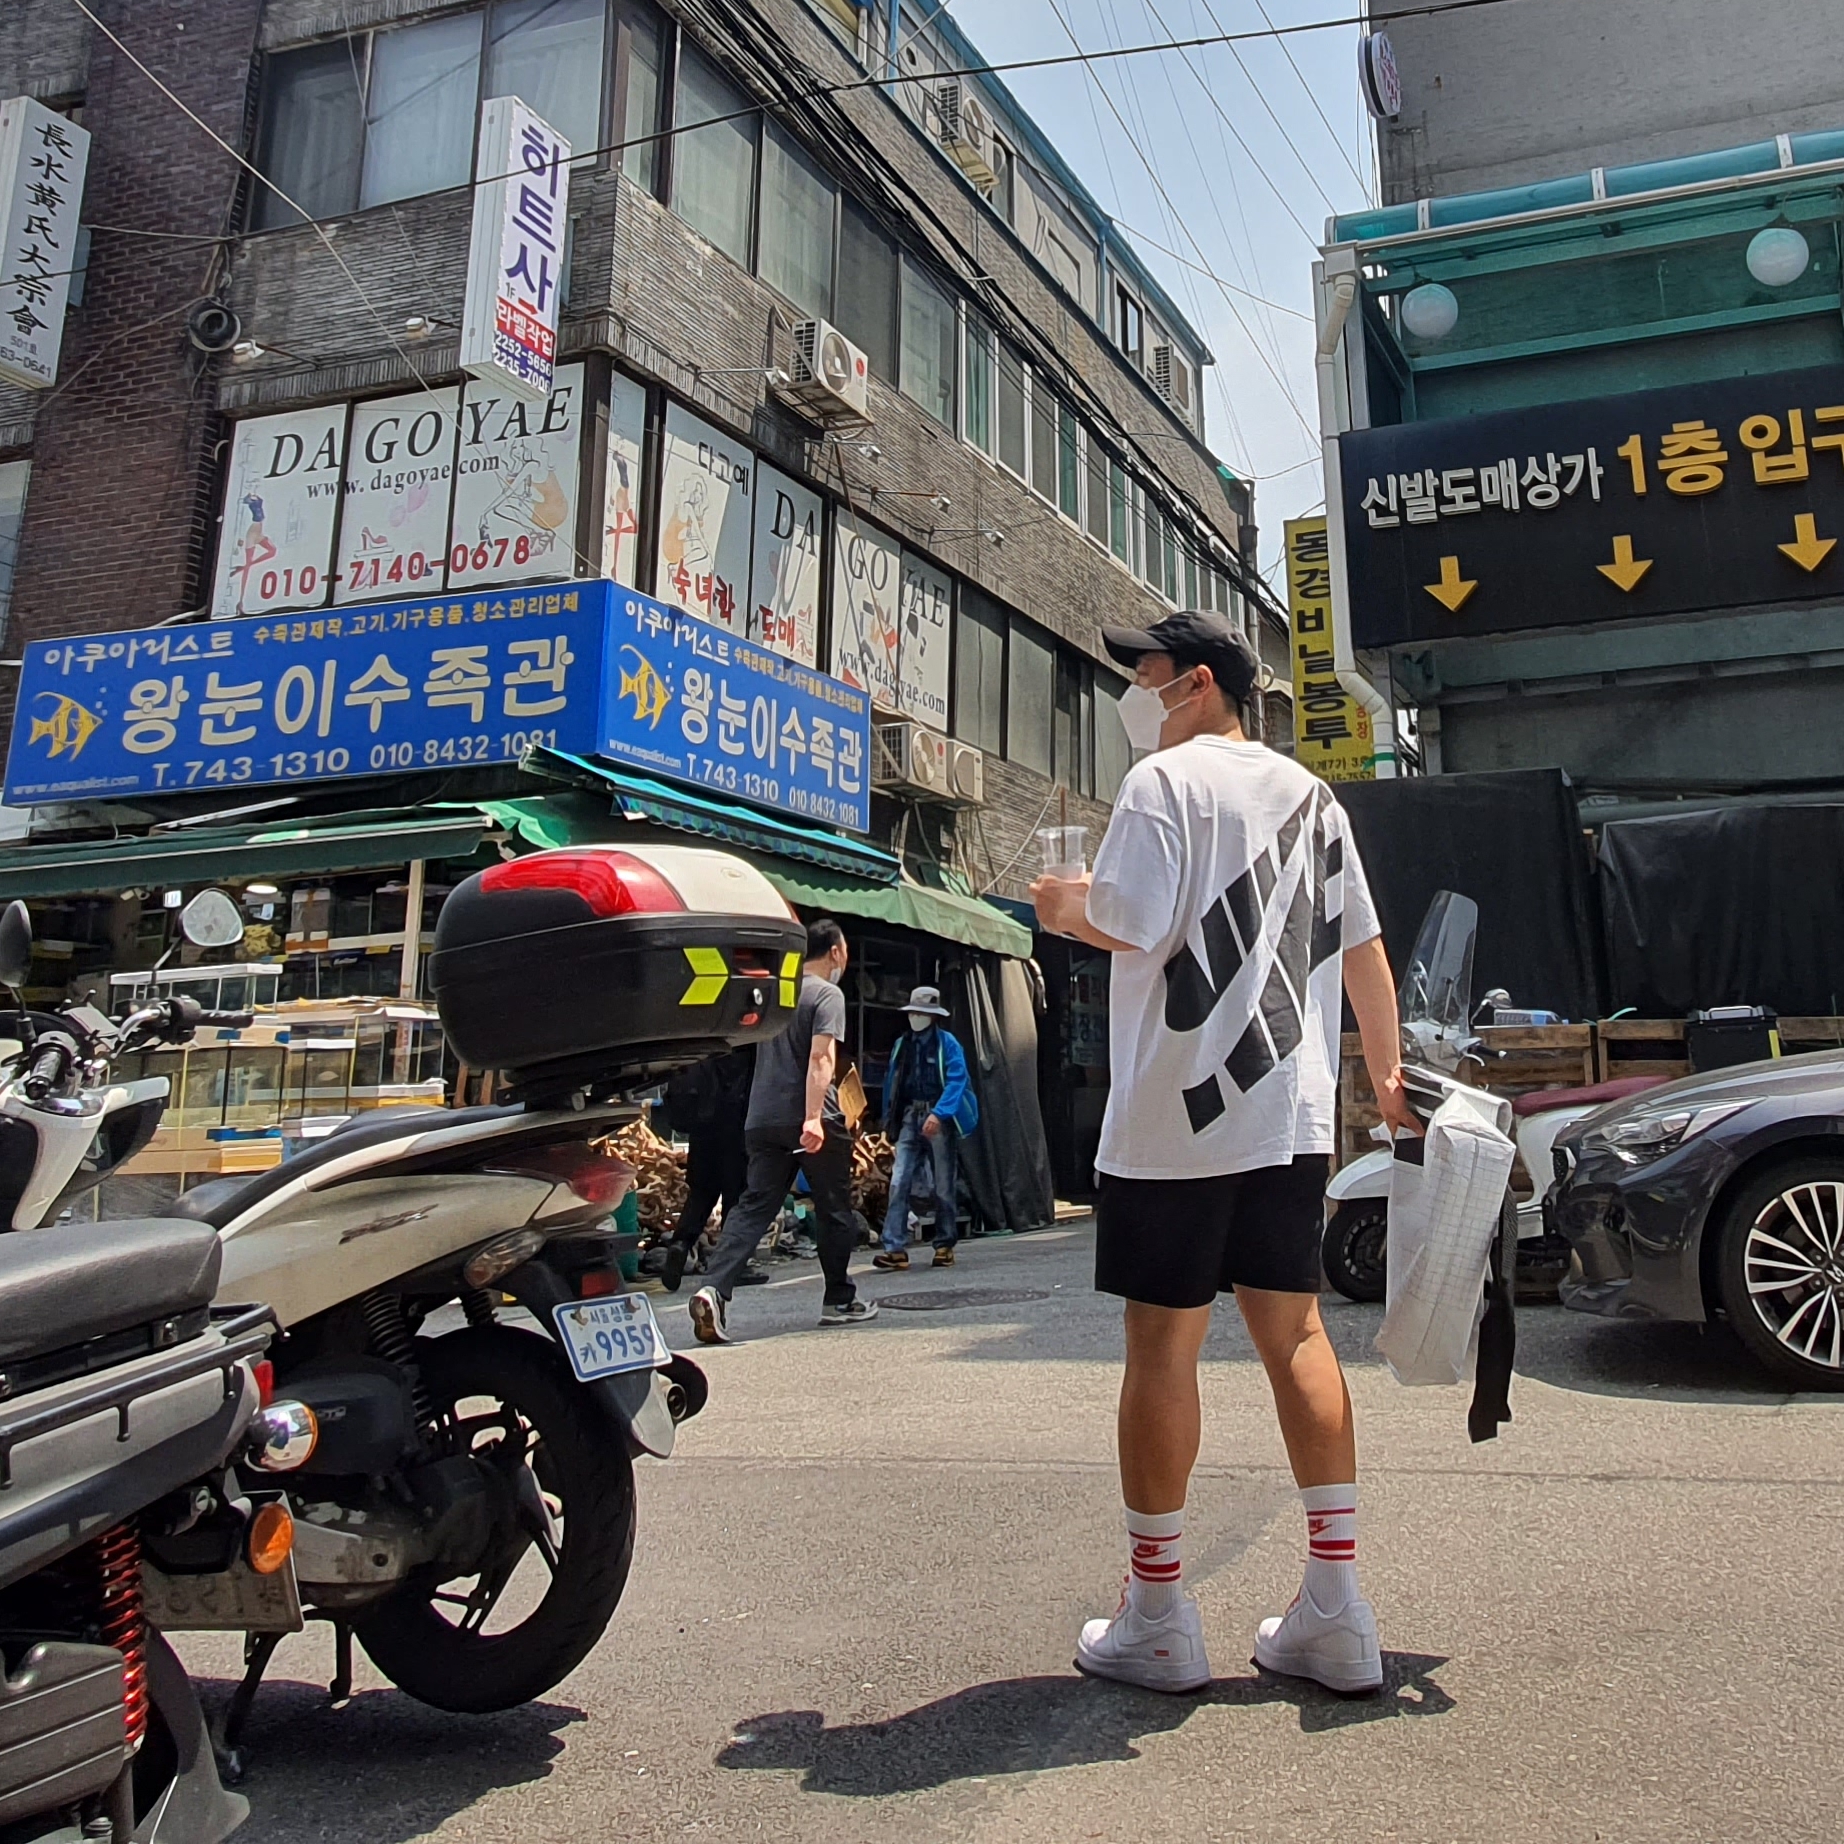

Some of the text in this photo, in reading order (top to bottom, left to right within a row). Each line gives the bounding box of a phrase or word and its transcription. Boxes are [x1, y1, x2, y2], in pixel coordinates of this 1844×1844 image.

[504, 124, 560, 313] 히트사
[498, 303, 553, 357] 라벨작업
[698, 441, 749, 497] 다고예
[1359, 447, 1604, 529] 신발도매상가
[1616, 419, 1730, 497] 1층
[260, 534, 532, 600] 010-7140-0678
[674, 556, 796, 650] 숙녀화 도매
[44, 630, 235, 676] 아쿠아리스트
[625, 600, 731, 668] 아쿠아리스트
[122, 634, 575, 755] 왕눈이수족관
[681, 667, 862, 795] 왕눈이수족관
